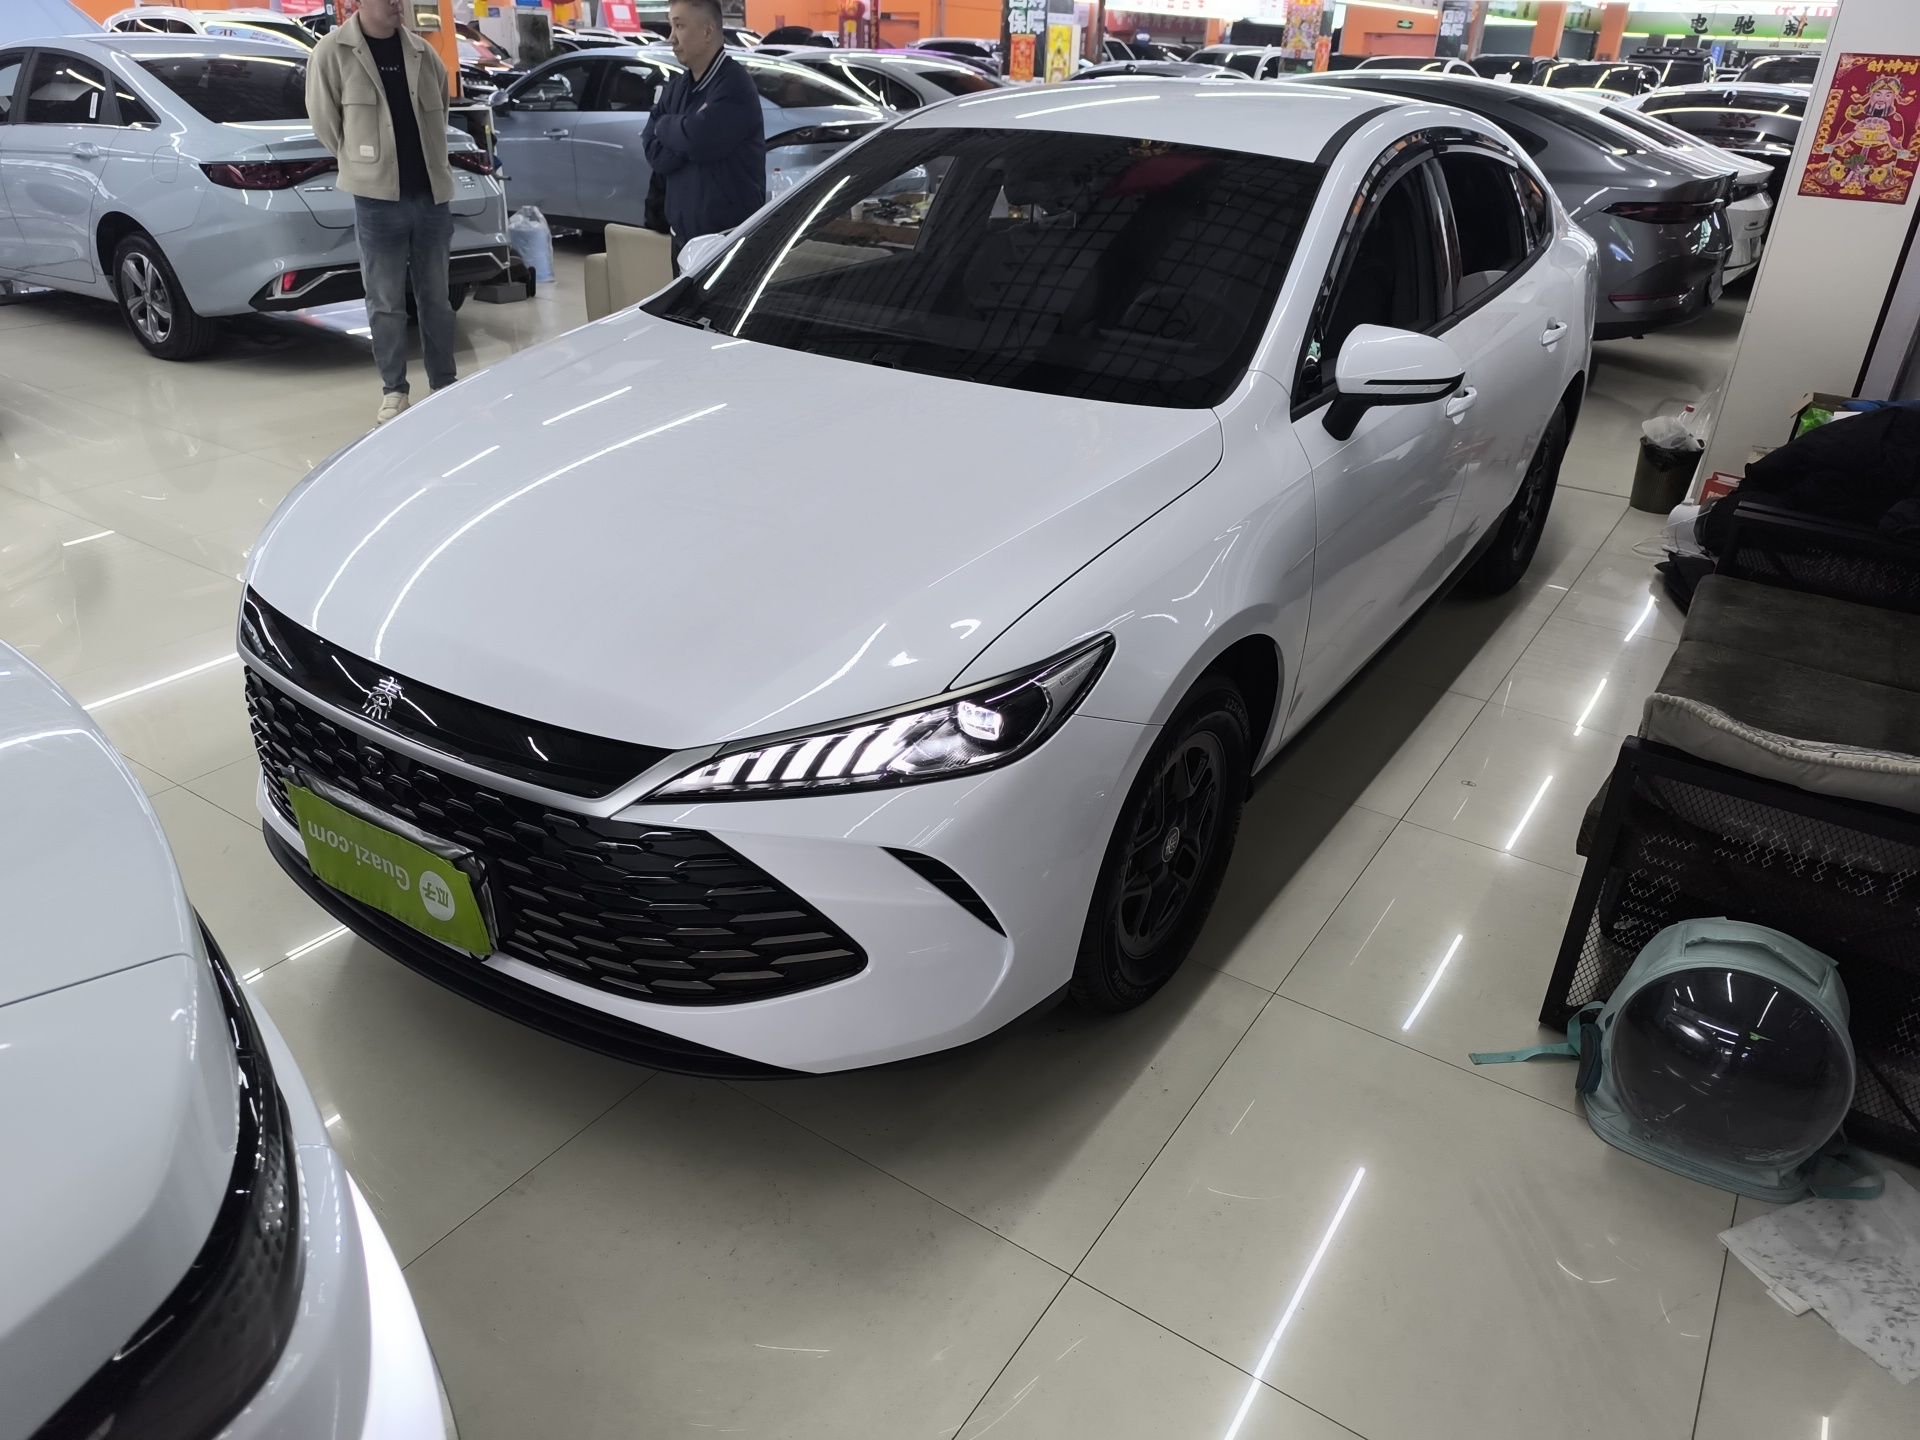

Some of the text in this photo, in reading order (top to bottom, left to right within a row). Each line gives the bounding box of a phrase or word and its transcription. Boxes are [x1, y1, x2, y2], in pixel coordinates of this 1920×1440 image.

[1866, 58, 1919, 75] 财神到
[307, 820, 410, 891] Guazi.com
[422, 881, 450, 909] 瓜子
